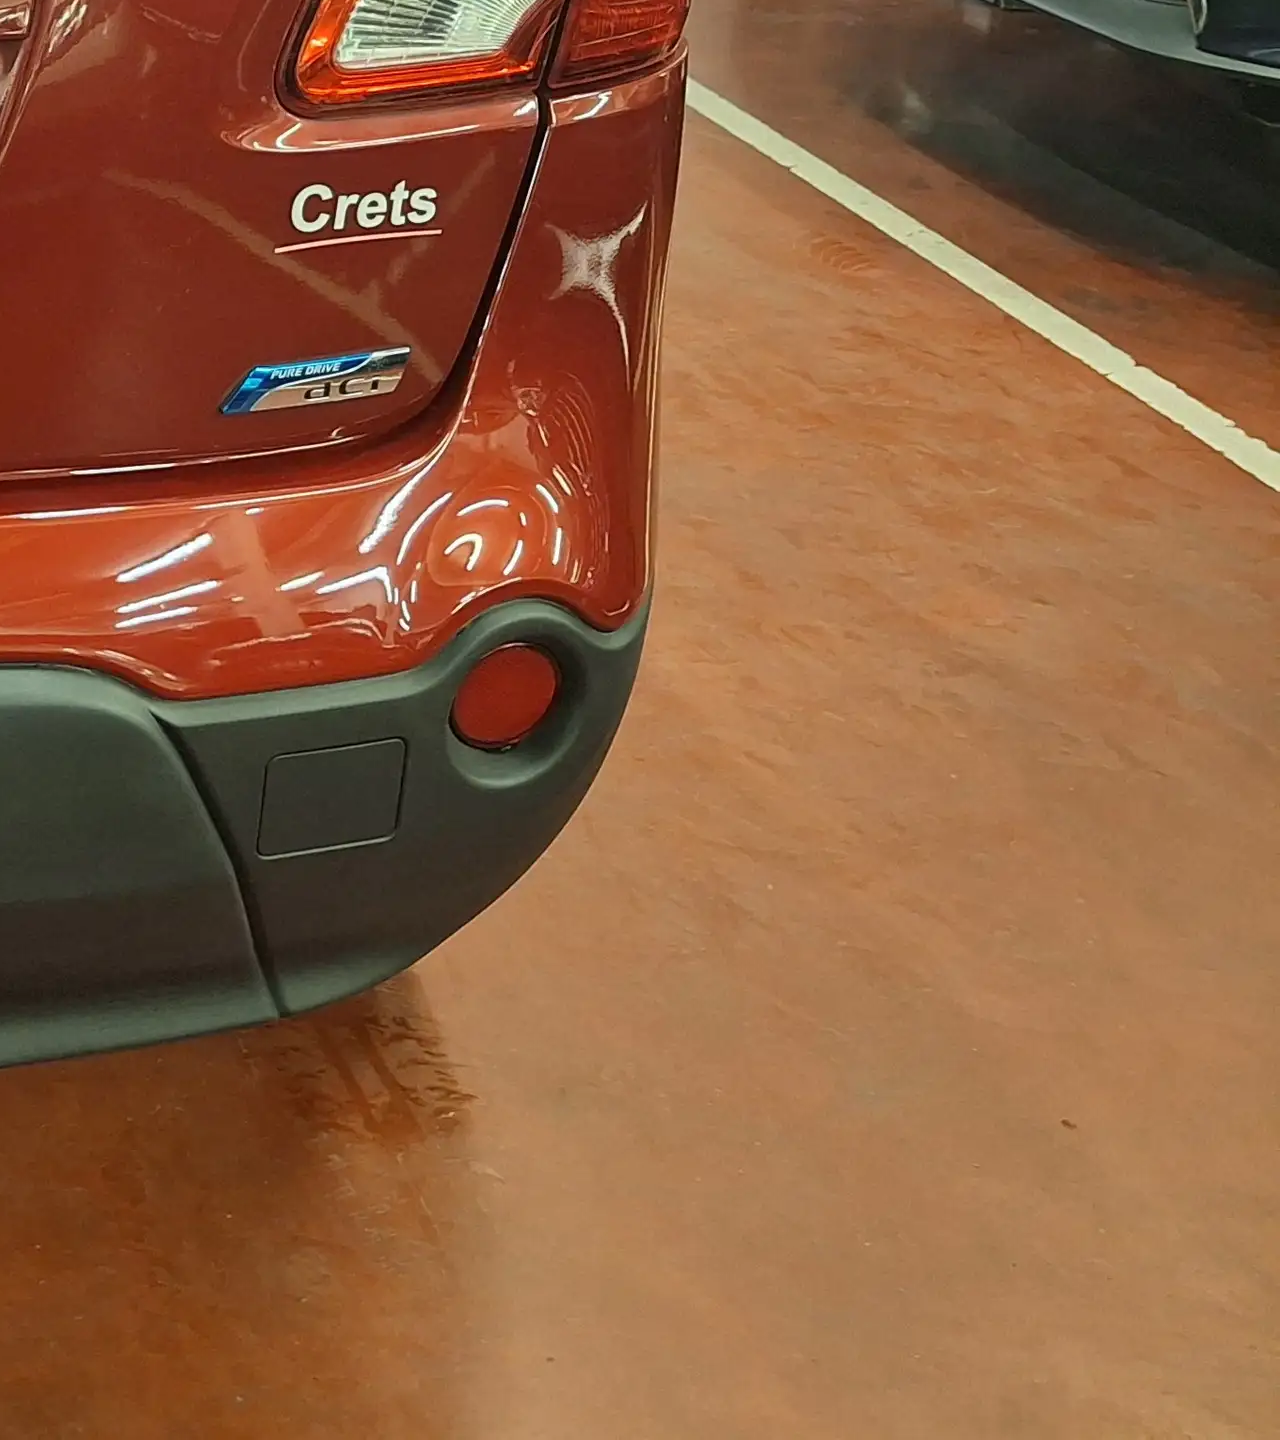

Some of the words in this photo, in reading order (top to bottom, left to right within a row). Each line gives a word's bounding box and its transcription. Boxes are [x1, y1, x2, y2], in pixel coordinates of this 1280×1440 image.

[291, 180, 438, 233] Crets
[270, 368, 303, 380] PURE
[306, 362, 342, 375] DRIVE
